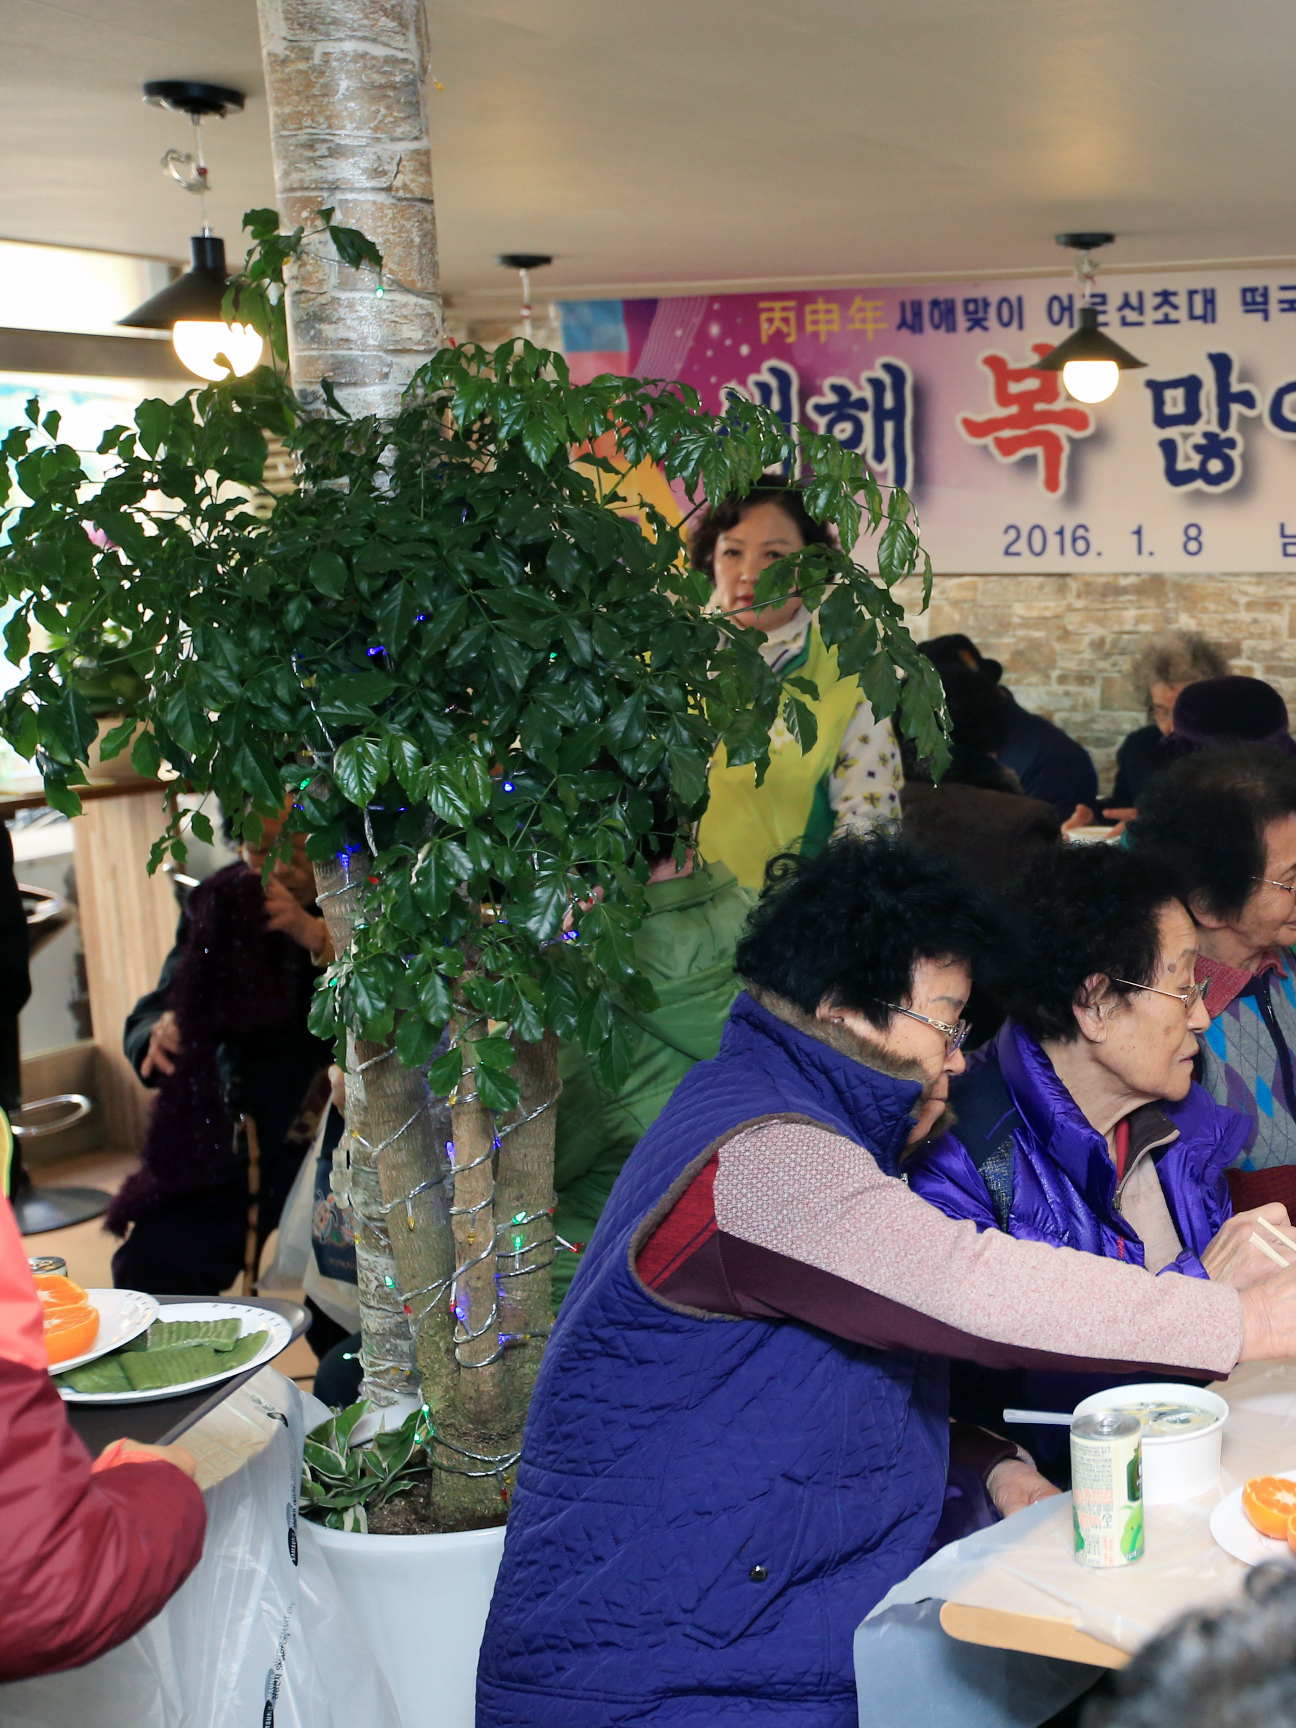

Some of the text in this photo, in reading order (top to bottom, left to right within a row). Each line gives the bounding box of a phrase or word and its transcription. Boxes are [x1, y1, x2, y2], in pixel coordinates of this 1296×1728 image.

[757, 295, 888, 344] 丙申年
[896, 294, 1025, 335] 새해맞이
[1046, 288, 1218, 329] 어르신초대
[960, 342, 1092, 495] 복
[1003, 522, 1204, 557] 2016. 1. 8
